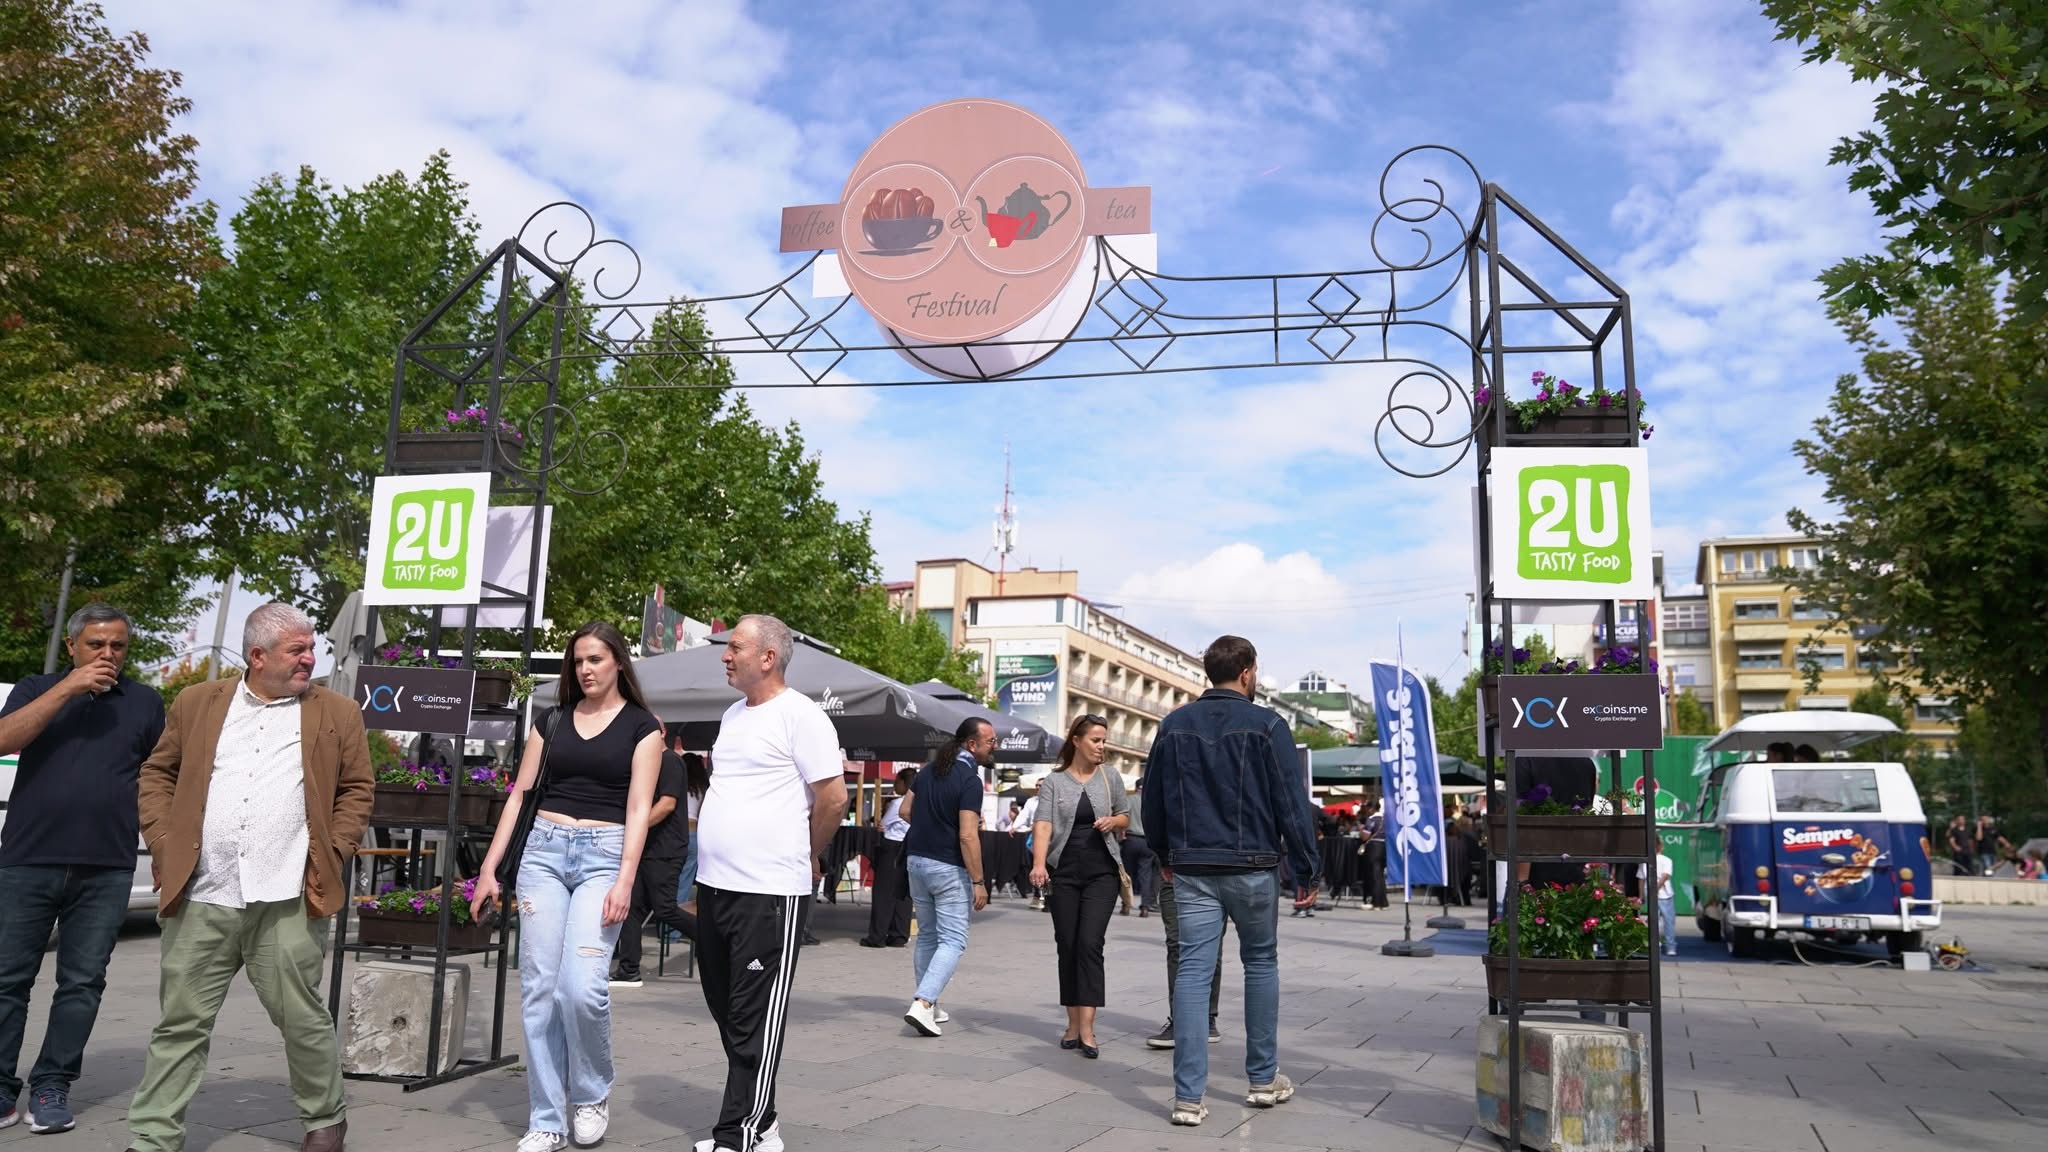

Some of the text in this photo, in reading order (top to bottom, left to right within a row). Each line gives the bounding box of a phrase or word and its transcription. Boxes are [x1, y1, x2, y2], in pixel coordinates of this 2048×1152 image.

[1106, 197, 1137, 220] tea
[906, 283, 1009, 318] Festival
[1528, 477, 1619, 548] 2U
[393, 500, 463, 561] 2U
[1529, 552, 1577, 572] TASTY
[392, 565, 426, 581] TASTY
[1603, 626, 1639, 635] CUS
[1011, 681, 1055, 692] 150 MW
[412, 693, 462, 704] exCoins.me
[815, 697, 844, 710] alla
[1011, 692, 1047, 702] WIND
[1582, 704, 1648, 714] exCoins.me
[1783, 827, 1854, 846] Sempre
